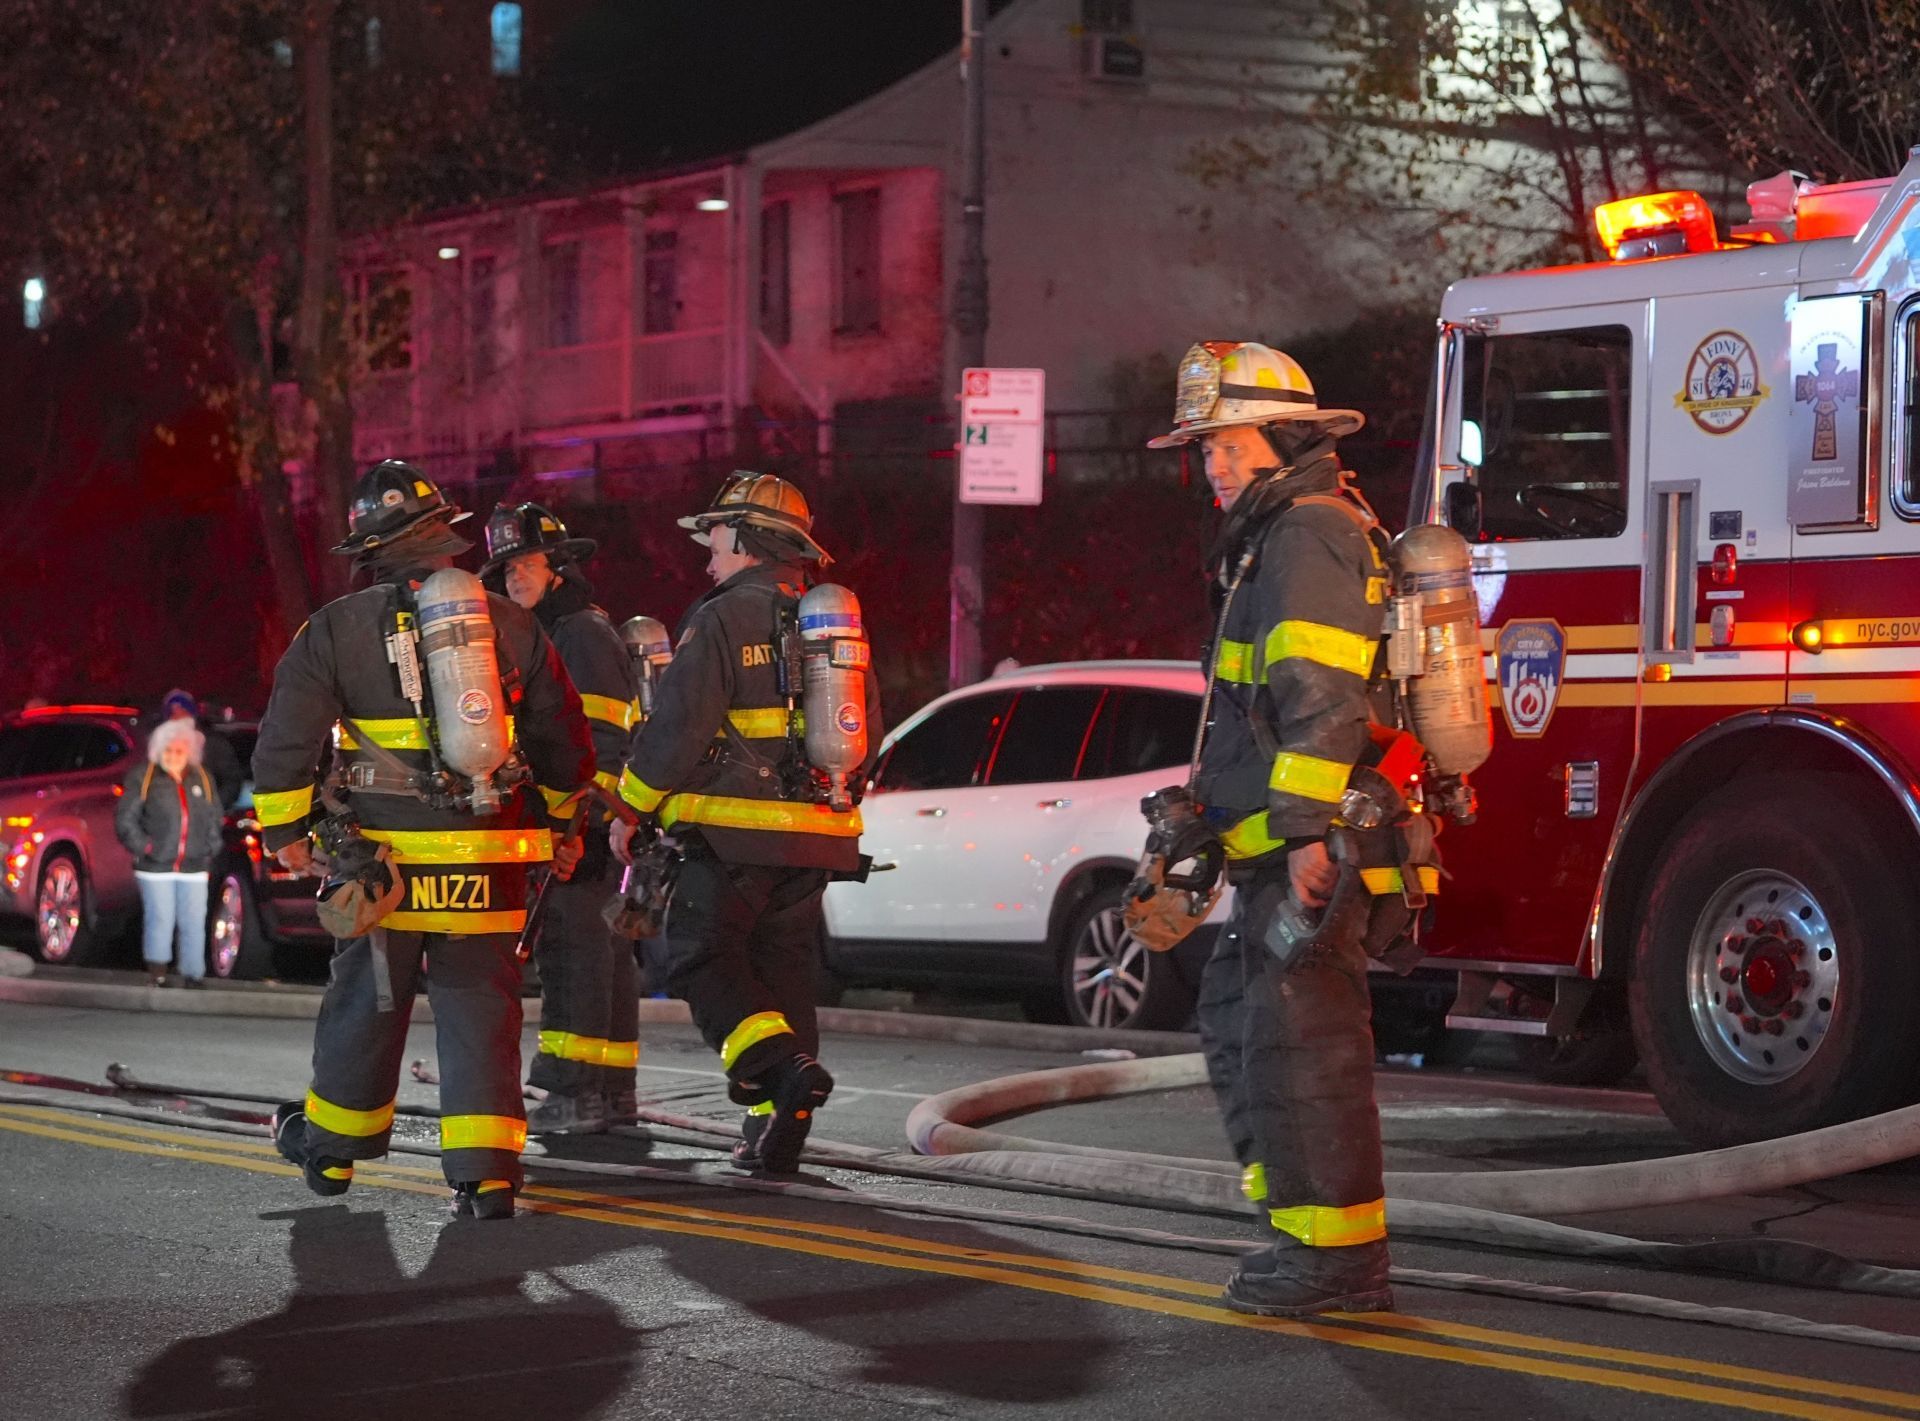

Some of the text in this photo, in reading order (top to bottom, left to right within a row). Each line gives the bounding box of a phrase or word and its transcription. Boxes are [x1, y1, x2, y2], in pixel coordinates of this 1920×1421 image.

[1706, 340, 1740, 358] FDNY
[1692, 382, 1704, 395] 81
[1740, 378, 1752, 390] 46
[1858, 622, 1920, 641] nyc.gov
[1517, 639, 1545, 649] CITY OF
[1512, 650, 1549, 660] NEW YORK
[411, 874, 490, 910] NUZZI
